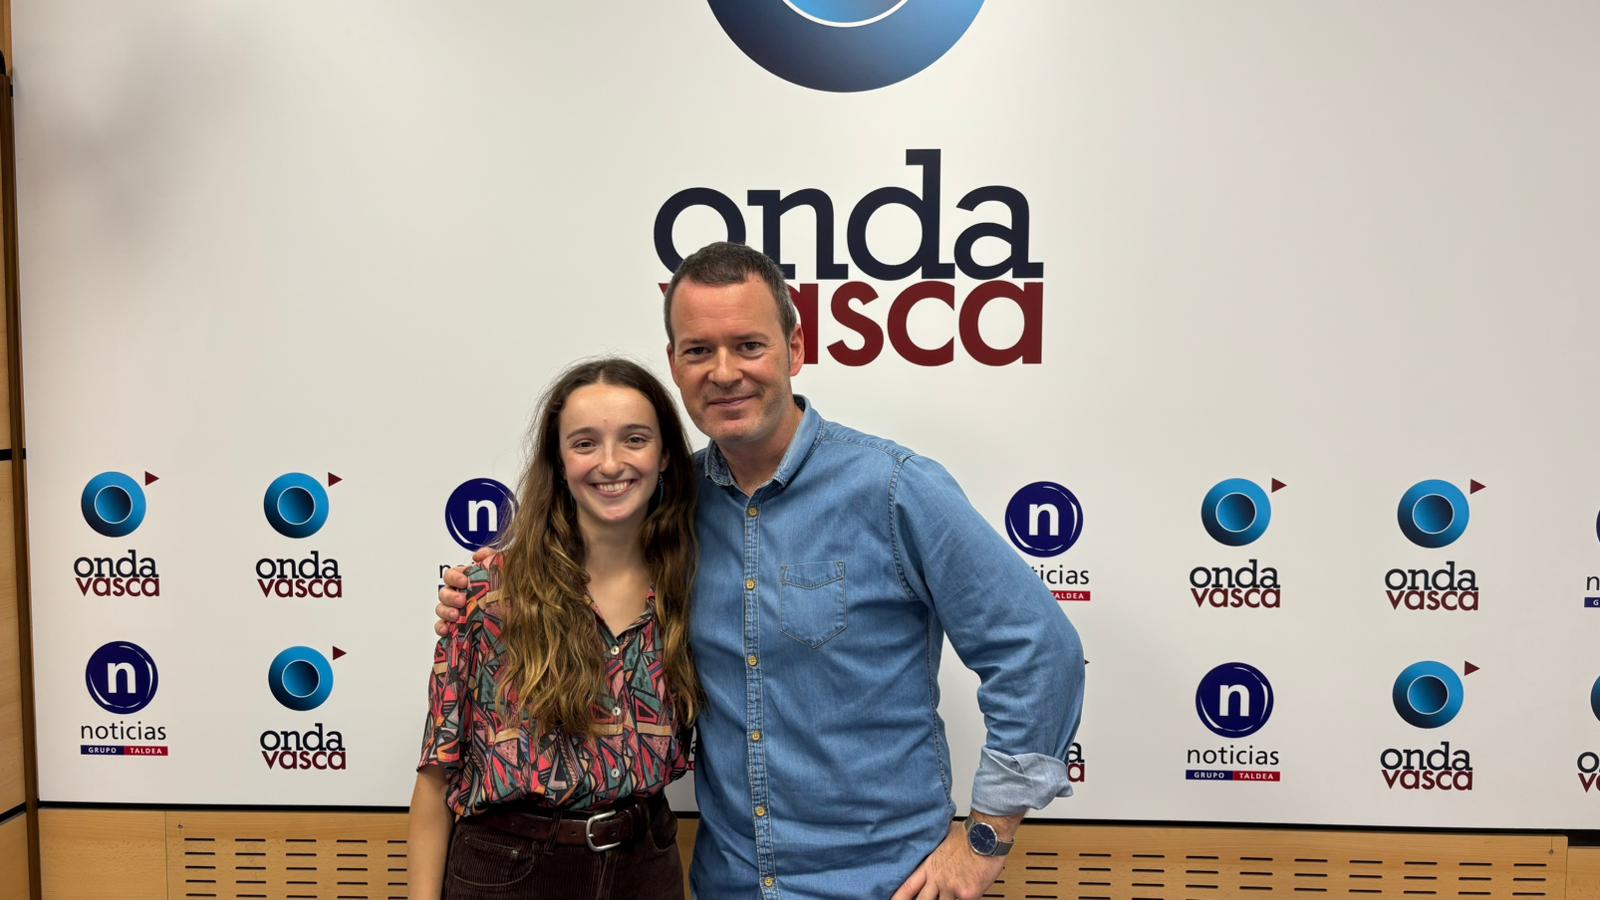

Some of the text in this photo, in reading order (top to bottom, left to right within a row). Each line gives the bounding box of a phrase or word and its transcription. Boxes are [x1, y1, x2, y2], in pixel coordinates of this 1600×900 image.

[653, 148, 1044, 281] onda
[658, 280, 1043, 367] sca
[468, 499, 498, 532] n
[1028, 503, 1059, 536] n
[74, 549, 159, 577] onda
[255, 550, 342, 579] onda
[1031, 564, 1089, 585] icias
[1190, 558, 1280, 588] onda
[1385, 561, 1478, 591] onda
[75, 577, 160, 597] vasca
[257, 579, 342, 598] vasca
[1051, 592, 1084, 600] ALDEA
[1190, 587, 1280, 609] vasca
[1385, 590, 1479, 611] vasca
[107, 662, 137, 694] n
[1219, 684, 1250, 717] n
[81, 720, 167, 741] noticias
[260, 723, 345, 751] onda
[261, 750, 346, 770] vasca
[1187, 744, 1279, 766] noticias
[1381, 741, 1473, 771] onda
[1193, 771, 1274, 780] GRUPO TALDEA
[1381, 769, 1473, 791] vasca
